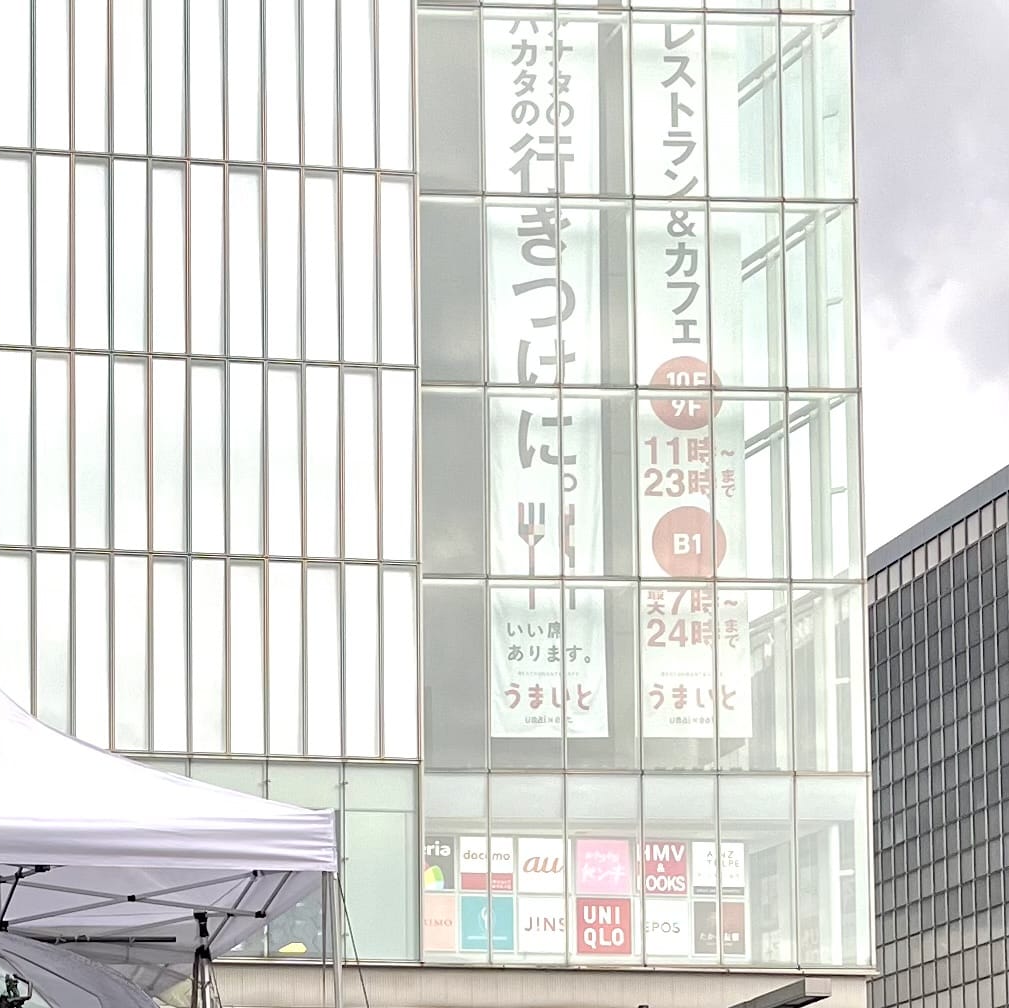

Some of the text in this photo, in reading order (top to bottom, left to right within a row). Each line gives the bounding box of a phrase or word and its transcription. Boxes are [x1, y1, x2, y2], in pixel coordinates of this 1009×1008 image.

[673, 534, 702, 555] B1
[636, 844, 686, 862] HMV
[522, 856, 565, 874] au
[583, 905, 621, 925] UNI
[583, 927, 625, 949] QLO
